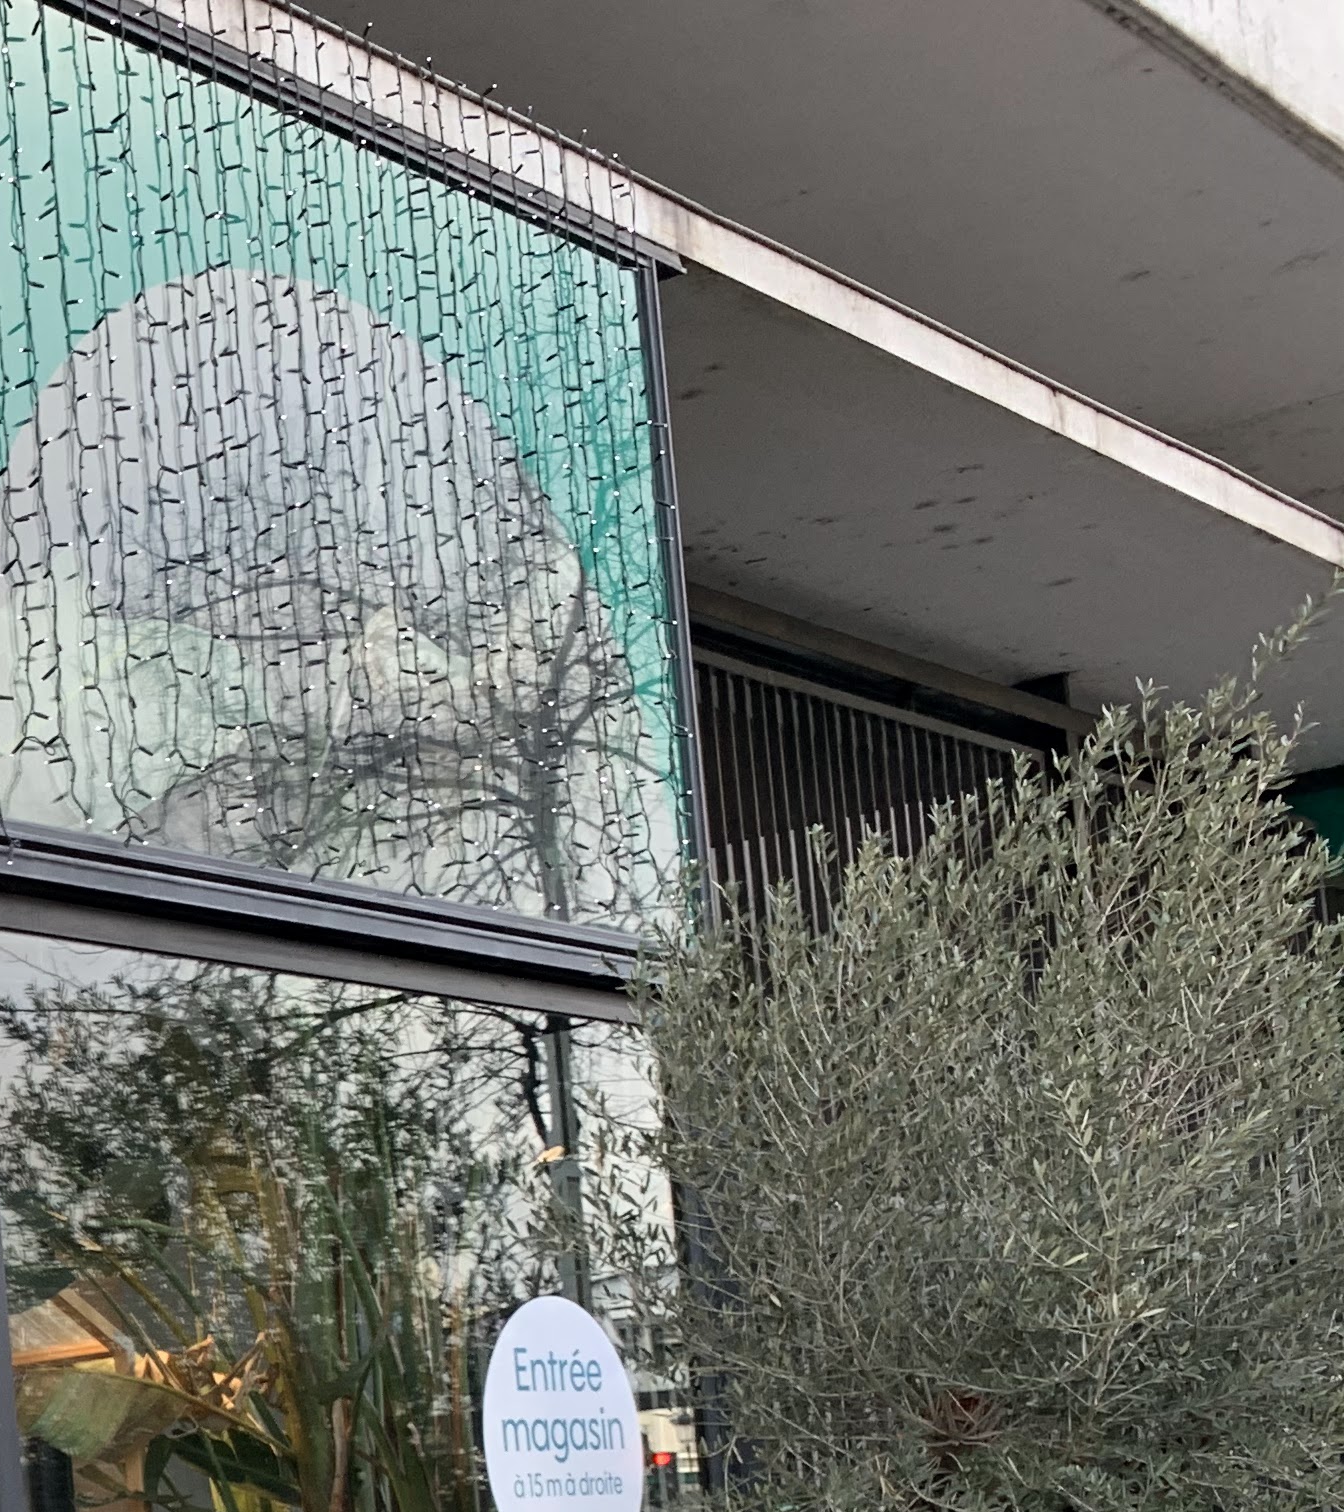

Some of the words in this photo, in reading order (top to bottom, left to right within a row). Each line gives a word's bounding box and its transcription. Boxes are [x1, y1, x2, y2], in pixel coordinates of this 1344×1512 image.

[513, 1347, 603, 1392] Entrée
[501, 1407, 626, 1463] magasin
[514, 1473, 526, 1498] à
[527, 1473, 543, 1498] 15
[547, 1477, 562, 1497] m
[566, 1472, 576, 1496] à
[579, 1471, 623, 1496] droite
